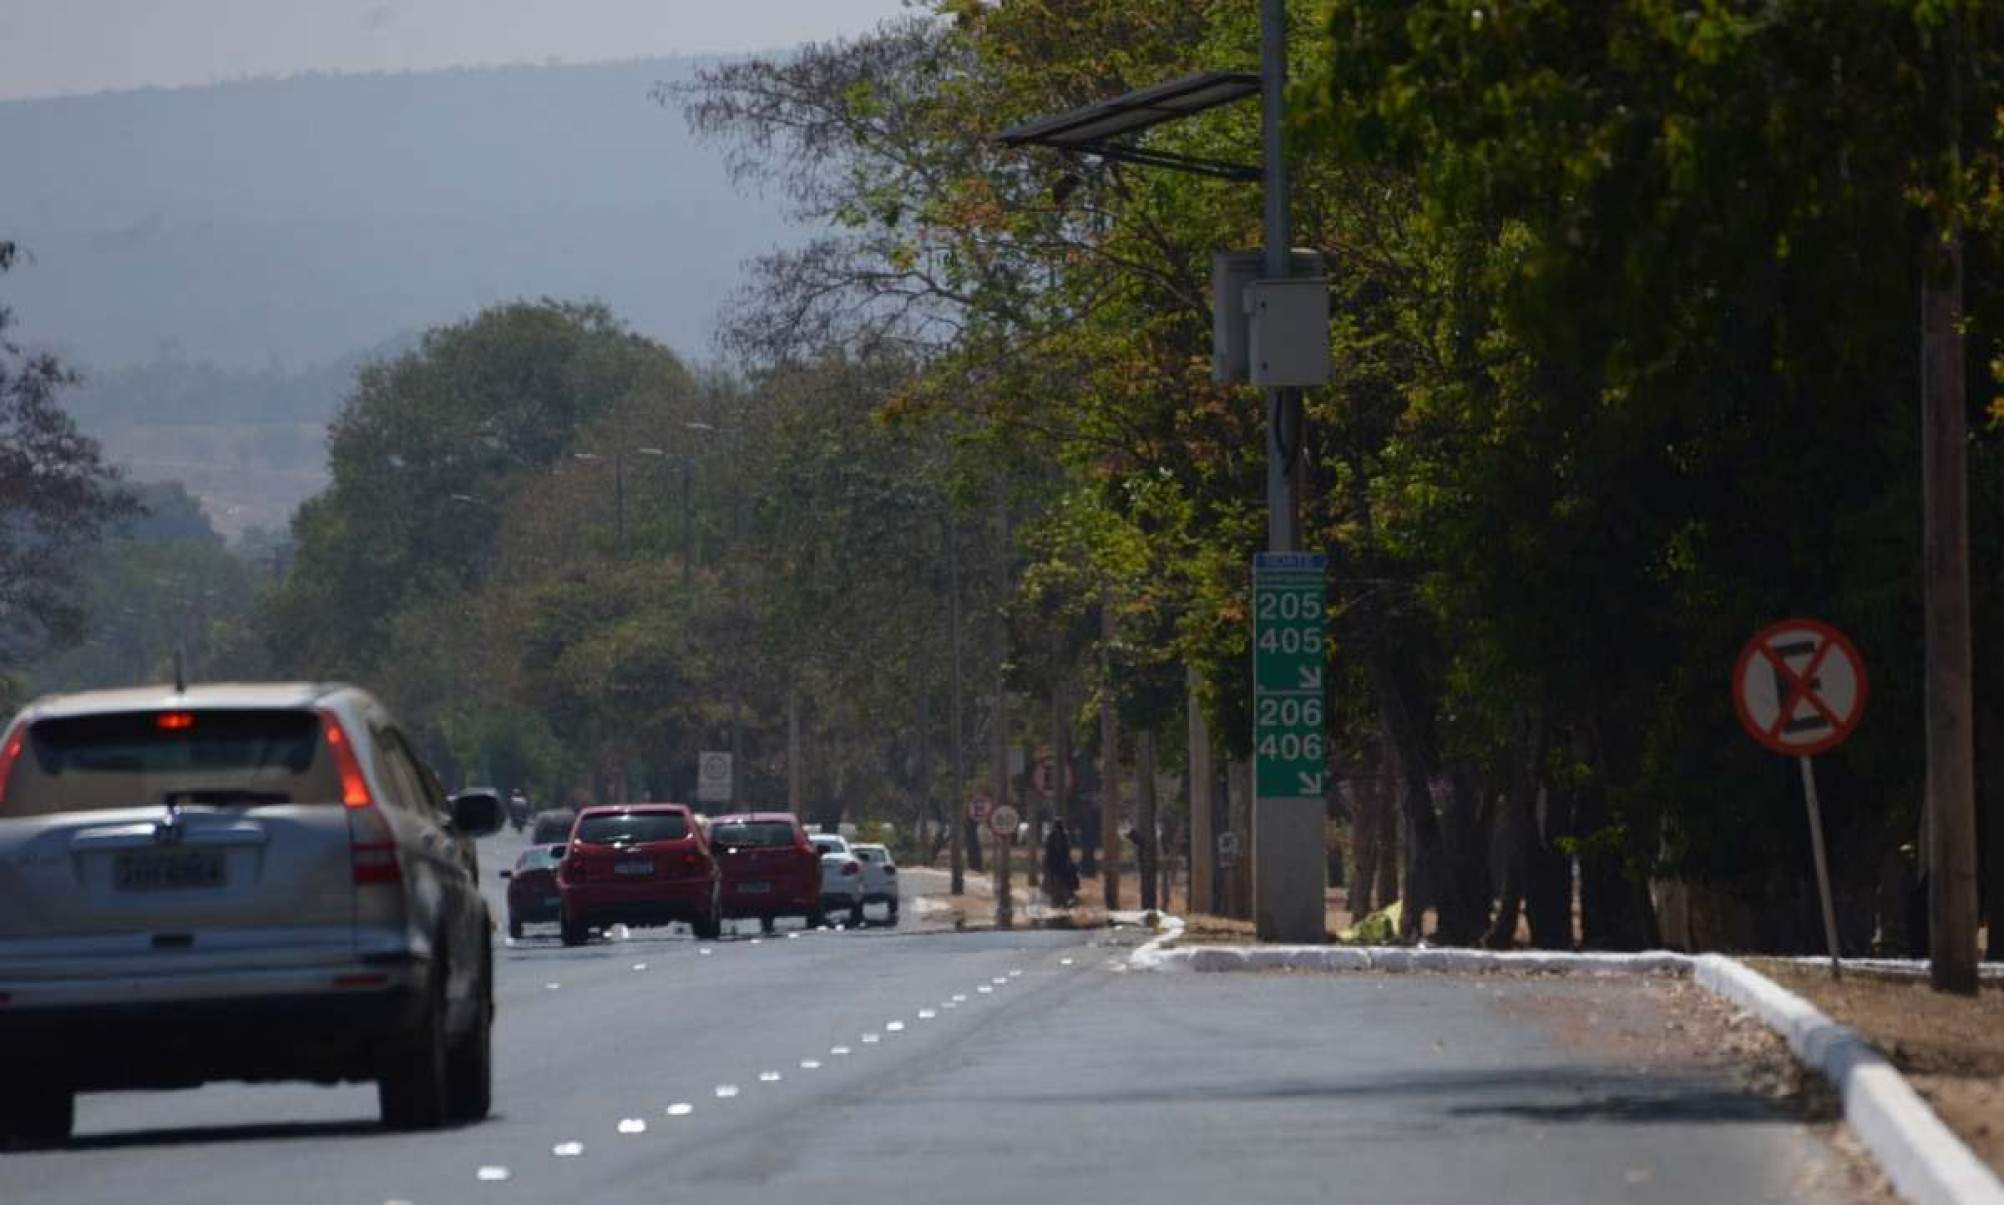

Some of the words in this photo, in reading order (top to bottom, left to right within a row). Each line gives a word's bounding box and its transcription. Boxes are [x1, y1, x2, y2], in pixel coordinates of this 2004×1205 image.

[1259, 592, 1321, 620] 205
[1259, 627, 1322, 654] 405
[1259, 698, 1322, 726] 206
[1259, 734, 1322, 761] 406
